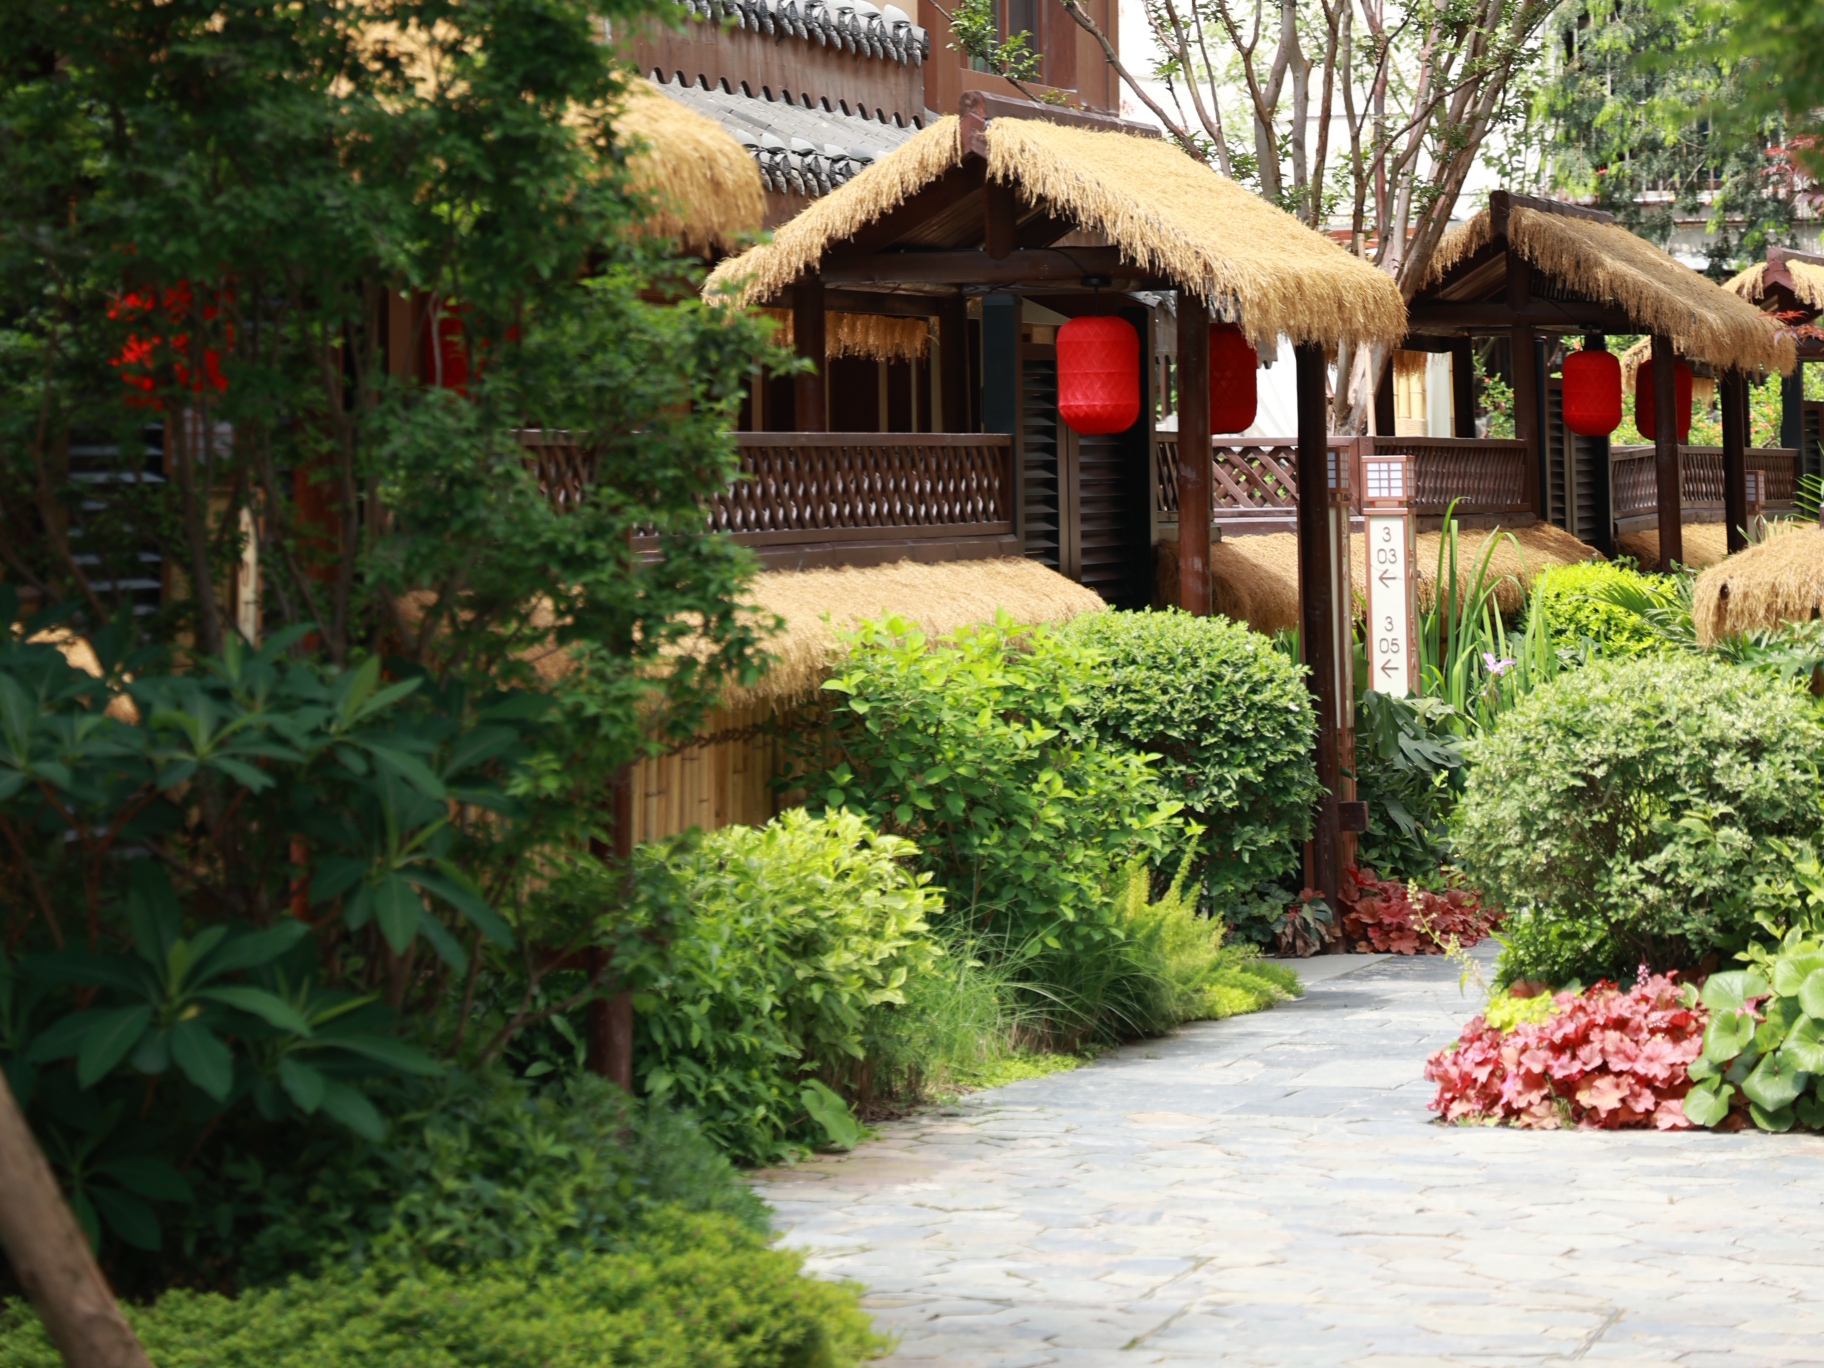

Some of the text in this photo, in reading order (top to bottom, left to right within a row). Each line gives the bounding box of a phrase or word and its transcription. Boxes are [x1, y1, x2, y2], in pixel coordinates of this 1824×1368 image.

[1382, 526, 1392, 542] 3
[1377, 548, 1397, 564] 03
[1384, 616, 1394, 632] 3
[1379, 638, 1400, 654] 05
